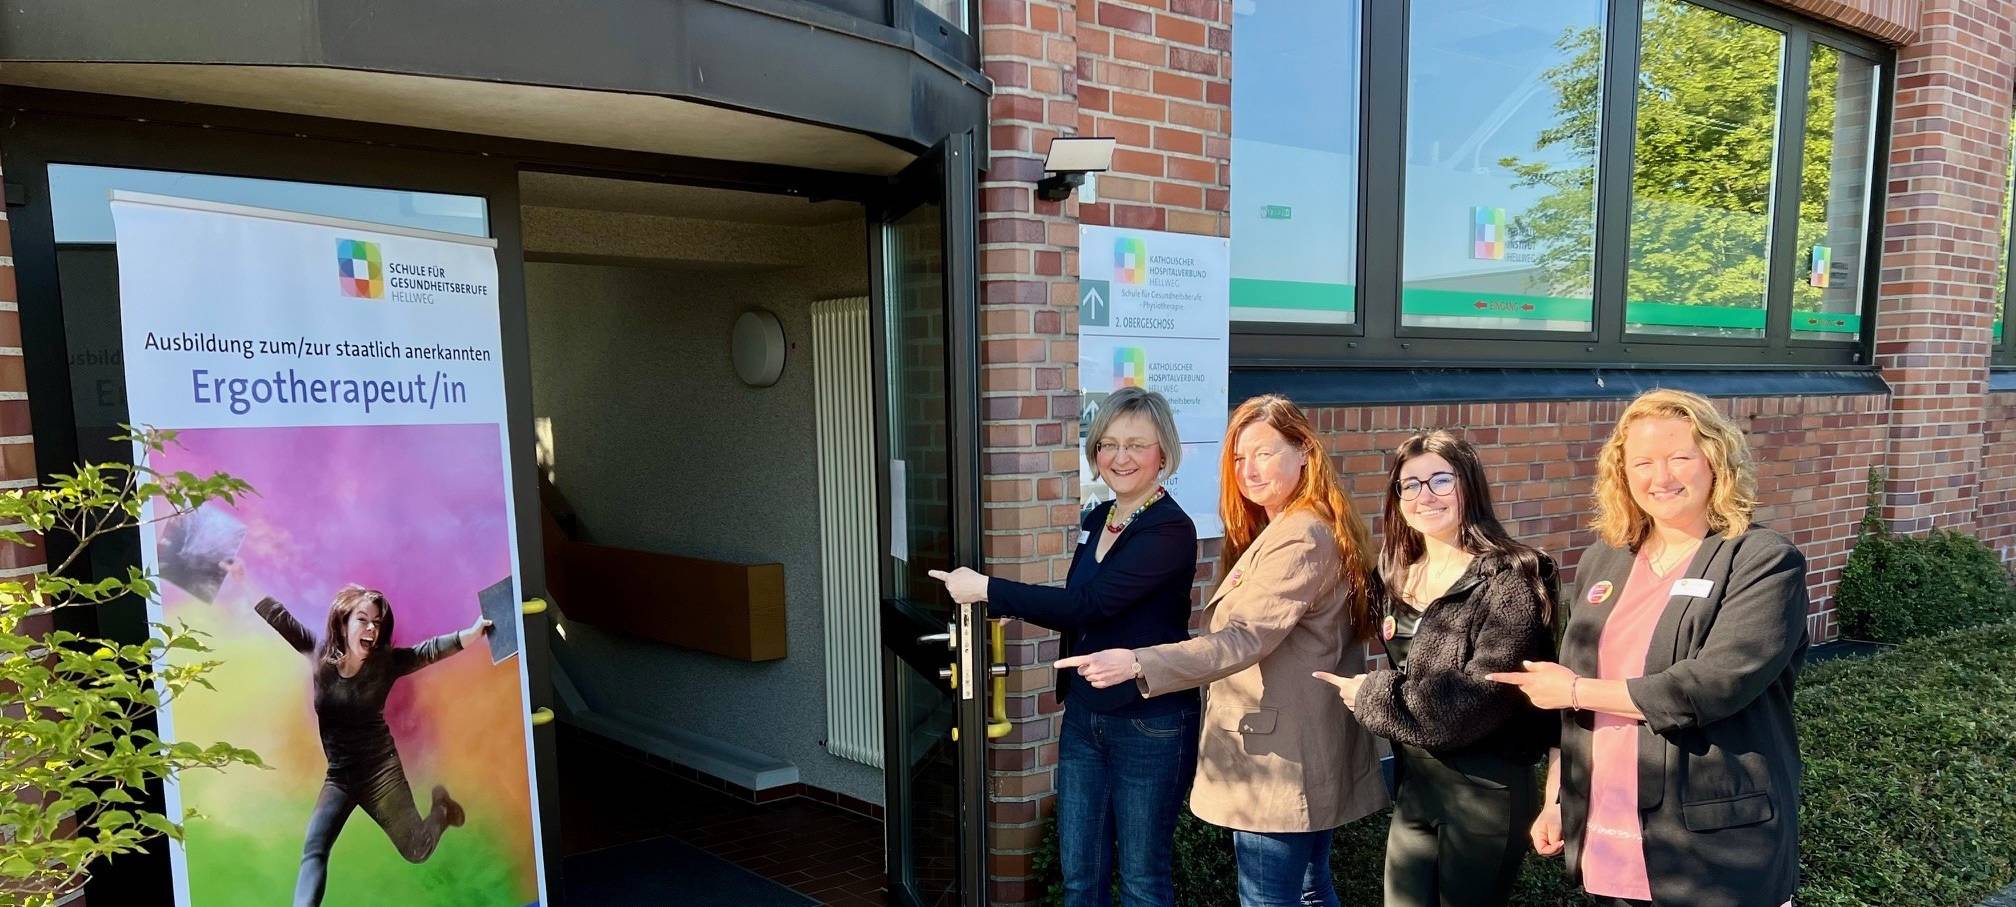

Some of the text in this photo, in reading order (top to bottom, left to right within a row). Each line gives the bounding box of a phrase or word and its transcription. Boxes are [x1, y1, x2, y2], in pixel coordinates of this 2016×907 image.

[1150, 255, 1195, 266] KATHOLISCHER
[389, 263, 446, 279] SCHULE FÜR
[1150, 267, 1207, 279] HOSPITALVERBUND
[390, 277, 488, 296] GESUNDHEITSBERUFE
[1150, 278, 1181, 288] HELLWEG
[391, 291, 435, 305] HELLWEG
[1121, 288, 1203, 301] Schule für Gesundheitsberufe
[1115, 317, 1175, 330] 2. OBERGESCHOSS
[144, 331, 491, 362] Ausbildung zum/zur staatlich anerkannten
[1148, 362, 1193, 371] KATHOLISCHER
[1148, 373, 1206, 383] HOSPITALVERBUND
[191, 368, 467, 415] Ergotherapeut/in
